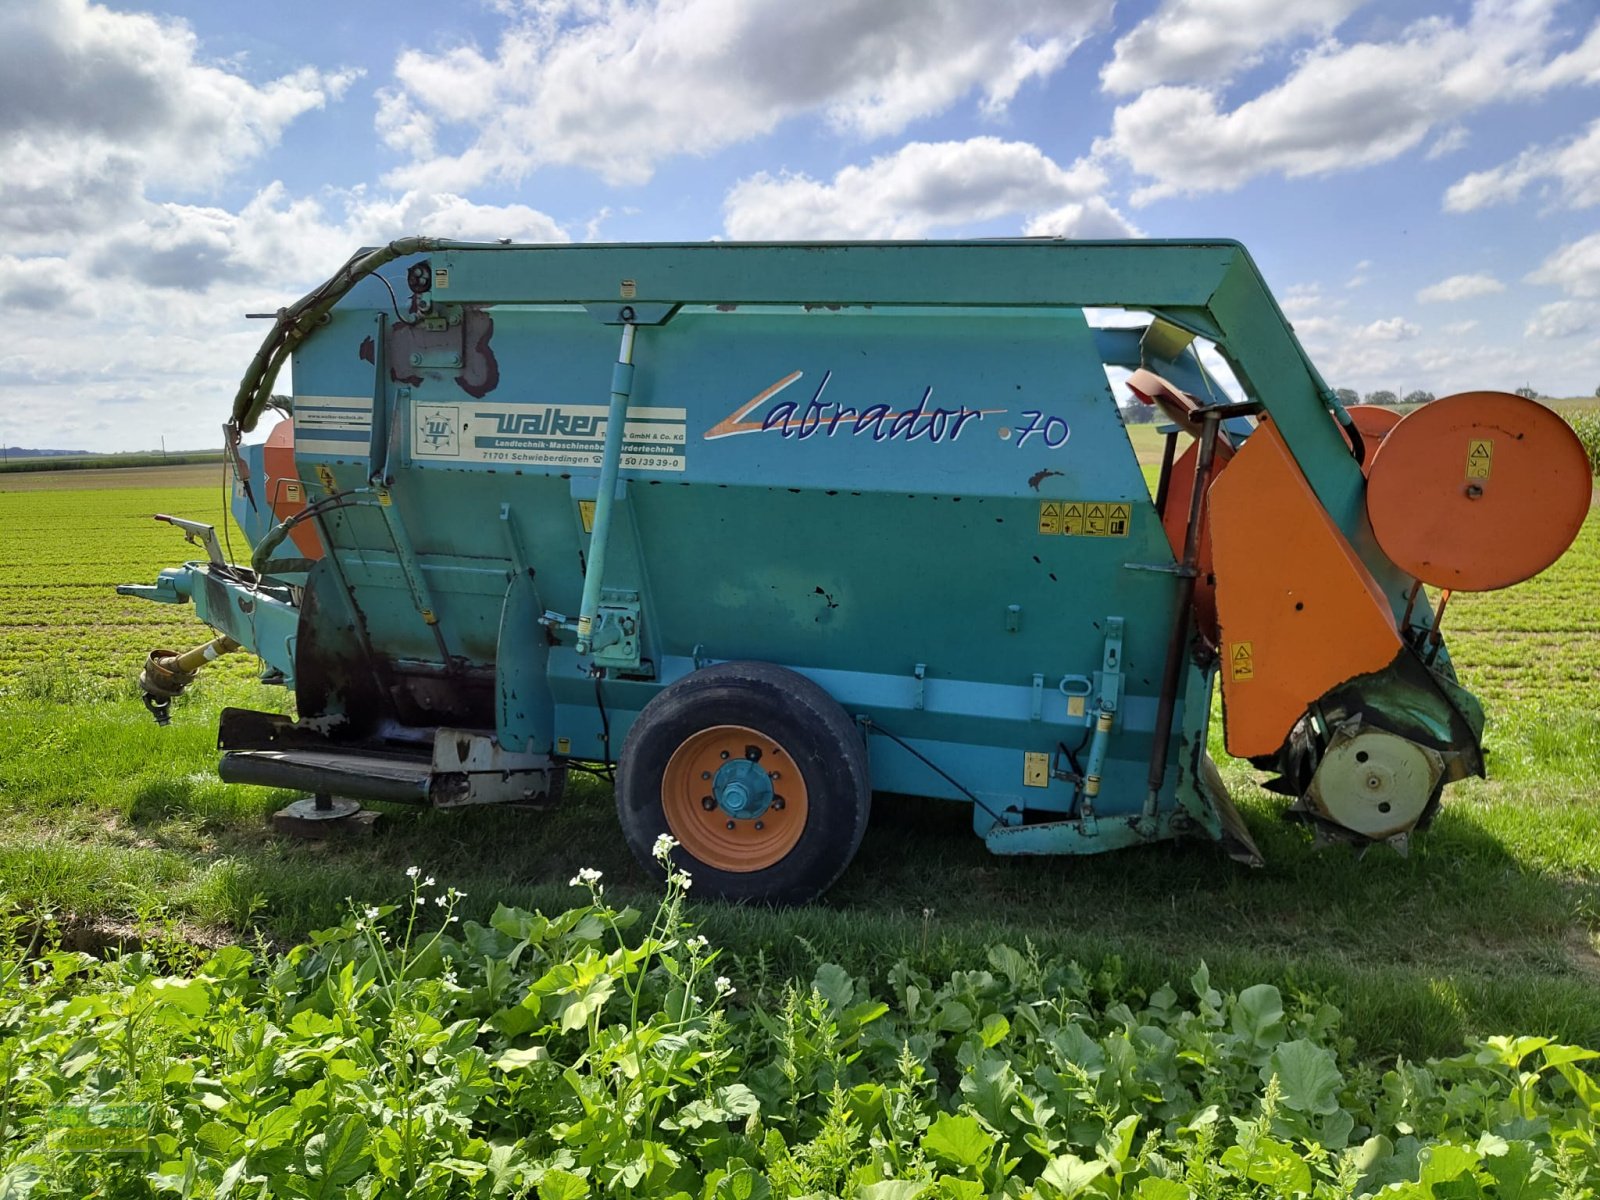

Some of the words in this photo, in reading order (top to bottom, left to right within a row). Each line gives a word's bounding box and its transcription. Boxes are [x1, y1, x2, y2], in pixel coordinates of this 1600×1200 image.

[496, 408, 601, 436] walker
[704, 370, 987, 443] Labrador
[1015, 409, 1070, 449] 70
[483, 452, 508, 460] 71701
[512, 453, 589, 464] Schwieberdingen
